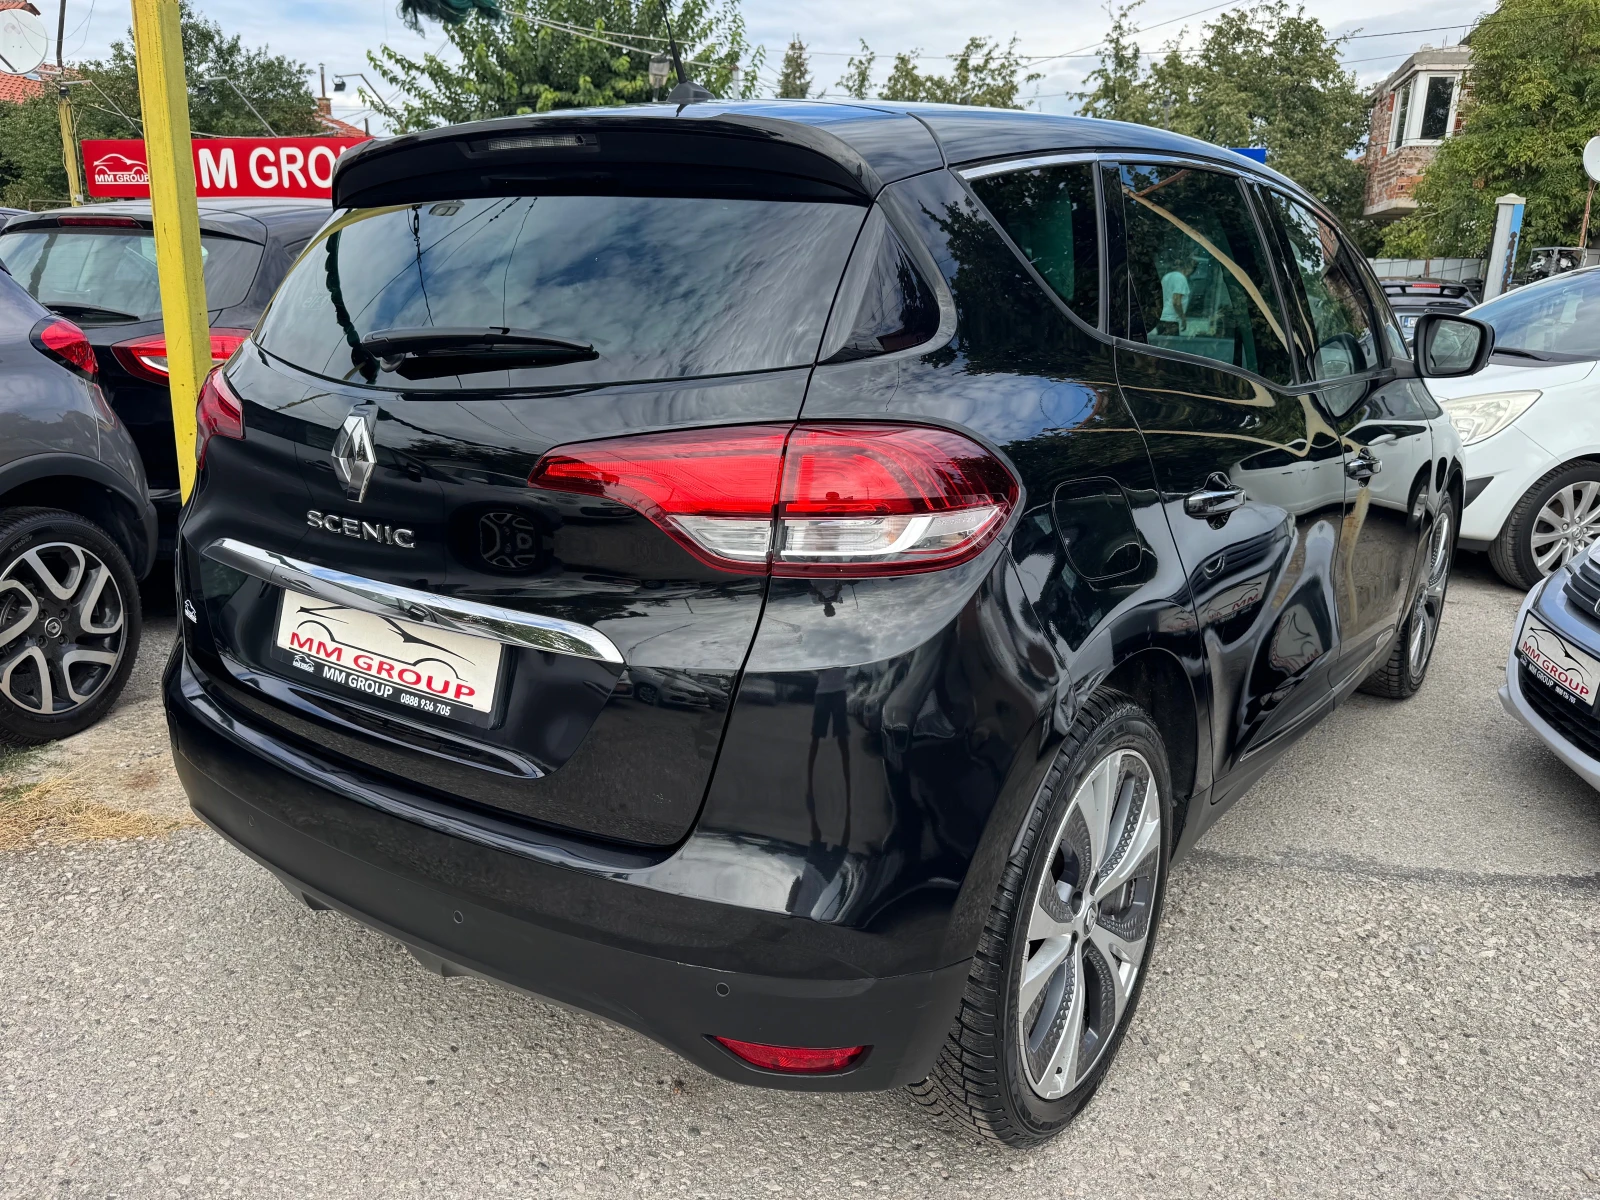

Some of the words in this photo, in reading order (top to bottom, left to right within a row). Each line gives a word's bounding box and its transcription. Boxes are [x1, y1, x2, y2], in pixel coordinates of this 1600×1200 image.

[95, 174, 114, 183] MM
[194, 147, 238, 189] M
[249, 146, 347, 189] GRO
[306, 510, 415, 548] SCENIC
[290, 632, 343, 662] MM
[353, 655, 476, 700] GROUP
[1523, 641, 1541, 662] MM
[1542, 659, 1589, 695] GROUP
[323, 665, 346, 684] MM
[348, 676, 393, 698] GROUP
[400, 693, 418, 708] 0888
[420, 698, 434, 712] 936
[435, 702, 451, 716] 705
